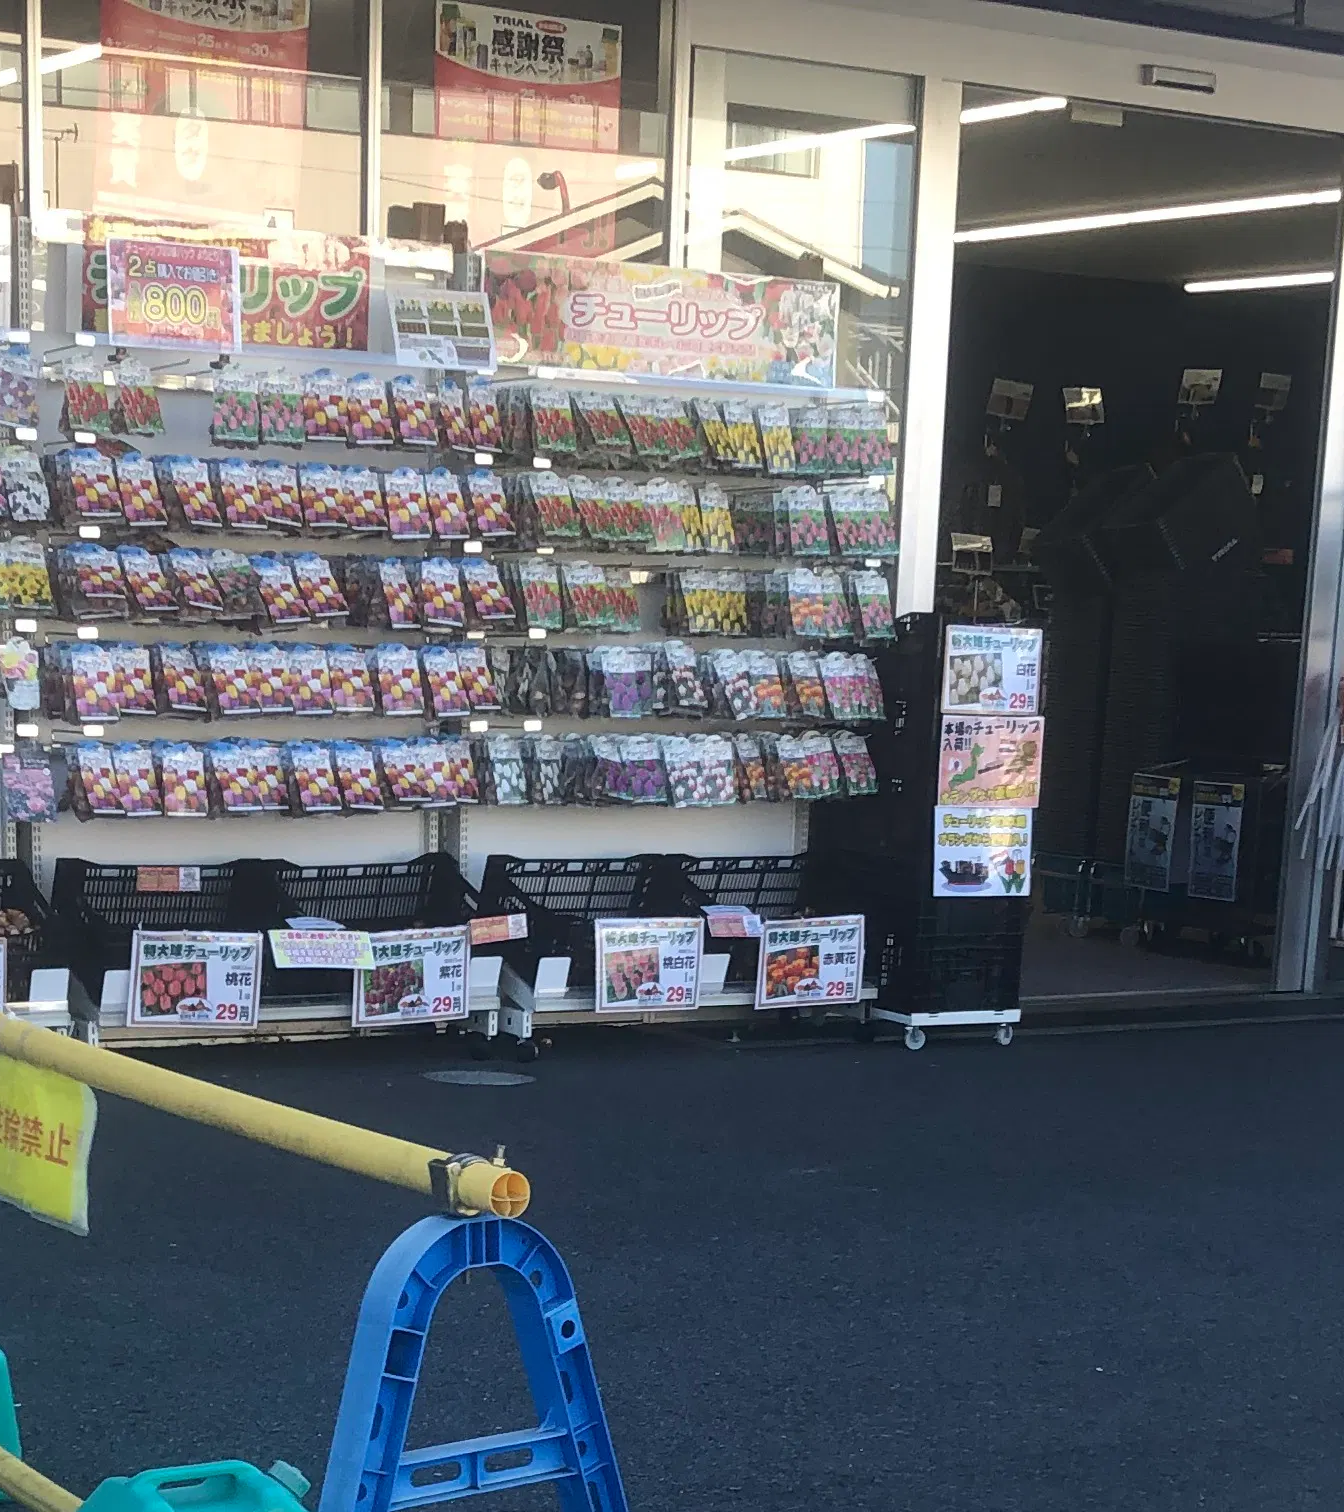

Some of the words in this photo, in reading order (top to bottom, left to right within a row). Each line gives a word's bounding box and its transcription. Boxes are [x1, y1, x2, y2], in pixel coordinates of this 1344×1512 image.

[492, 14, 534, 29] TRIAL
[492, 29, 564, 64] 感謝祭
[143, 282, 208, 325] 800
[570, 292, 766, 342] チューリップ
[944, 719, 1042, 737] 本場のチューリップ
[662, 955, 696, 970] 桃白花
[225, 971, 253, 987] 桃花
